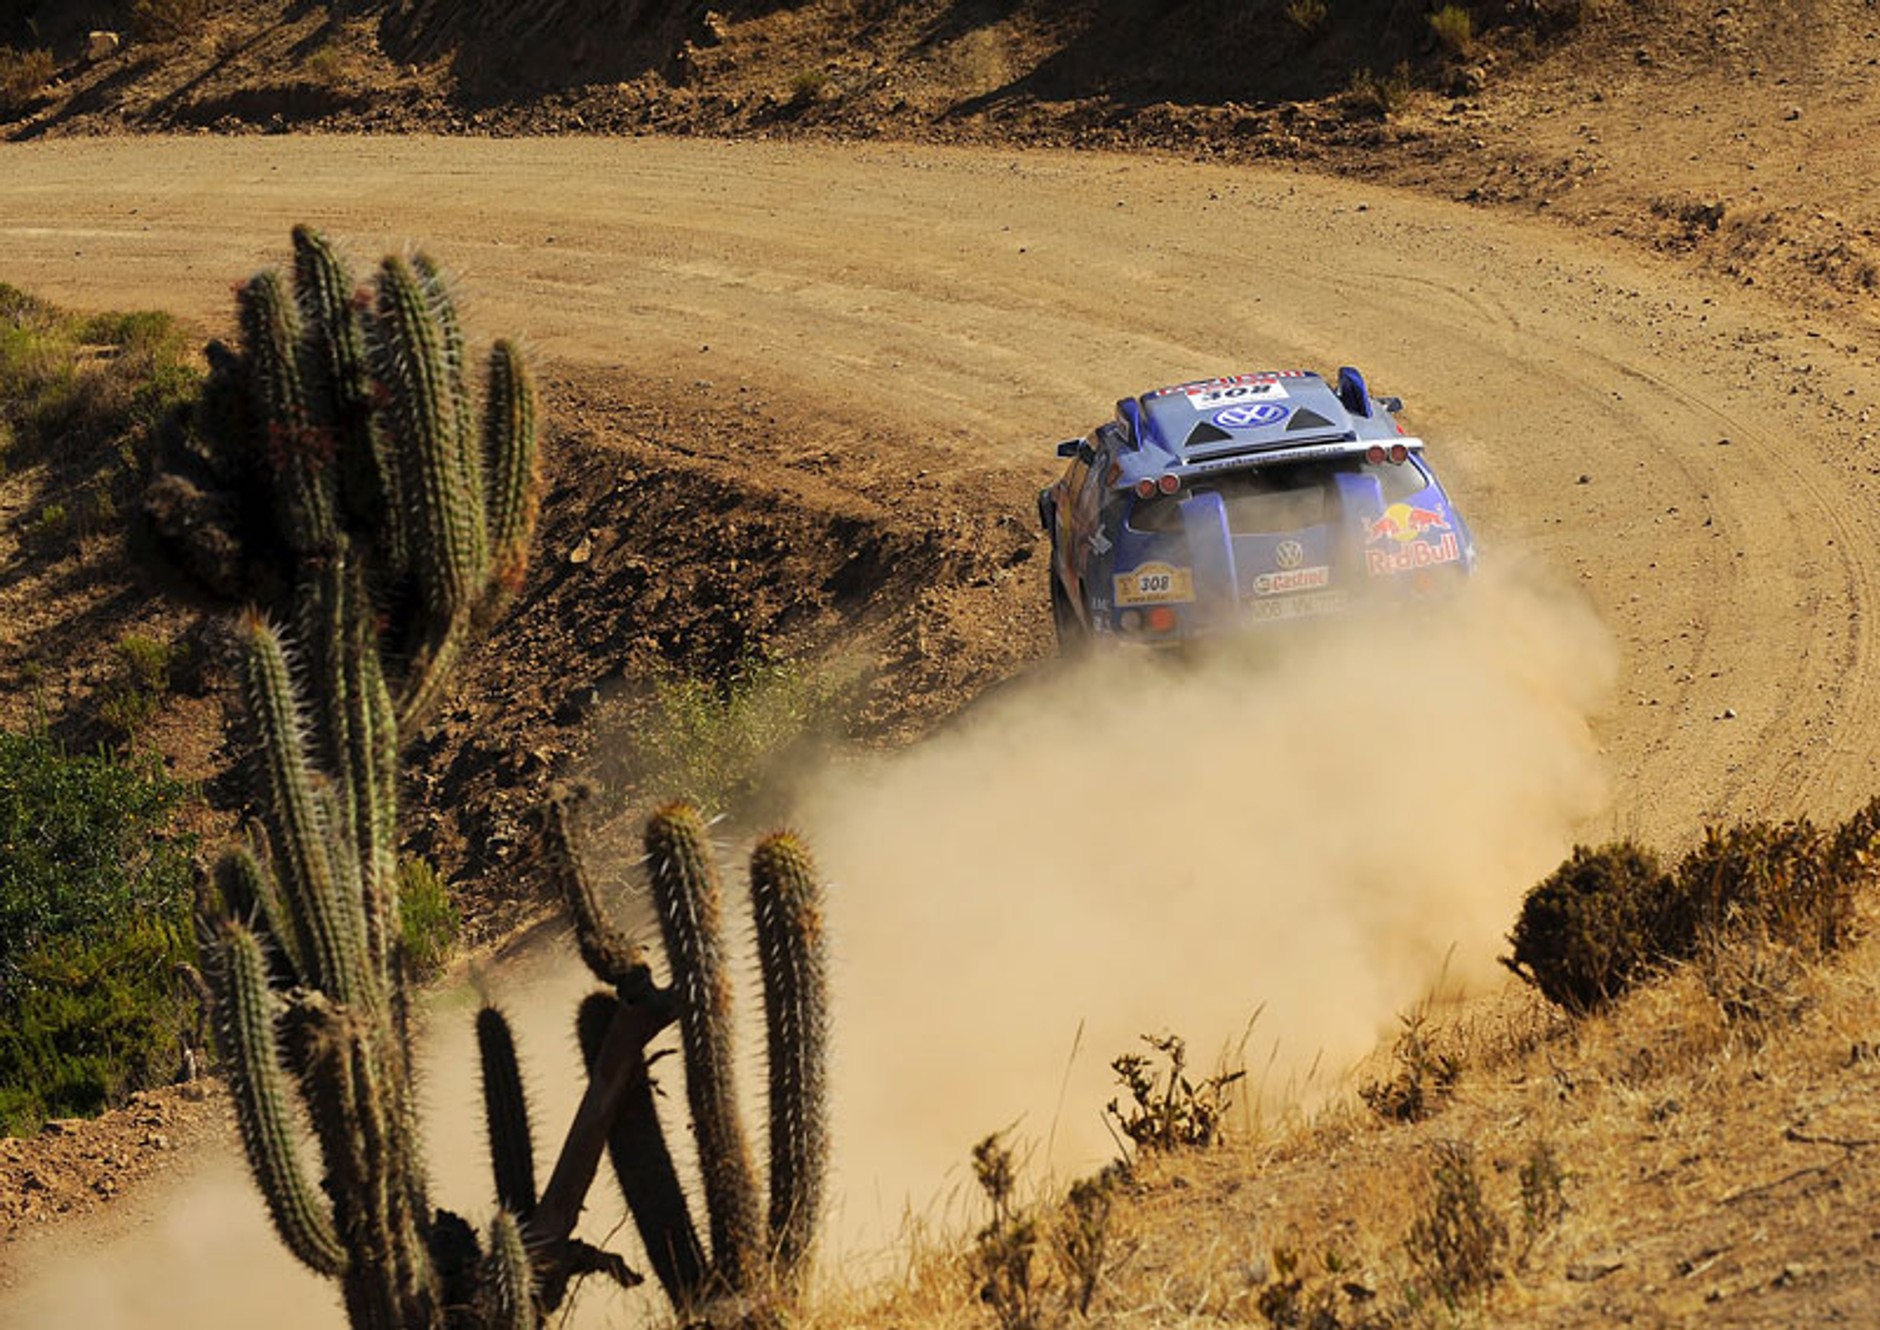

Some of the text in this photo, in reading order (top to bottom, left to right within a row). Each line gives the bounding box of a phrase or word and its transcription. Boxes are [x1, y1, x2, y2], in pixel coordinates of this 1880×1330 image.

[1366, 533, 1459, 576] Red Bull
[1140, 575, 1170, 592] 308
[1273, 569, 1325, 591] Castrol
